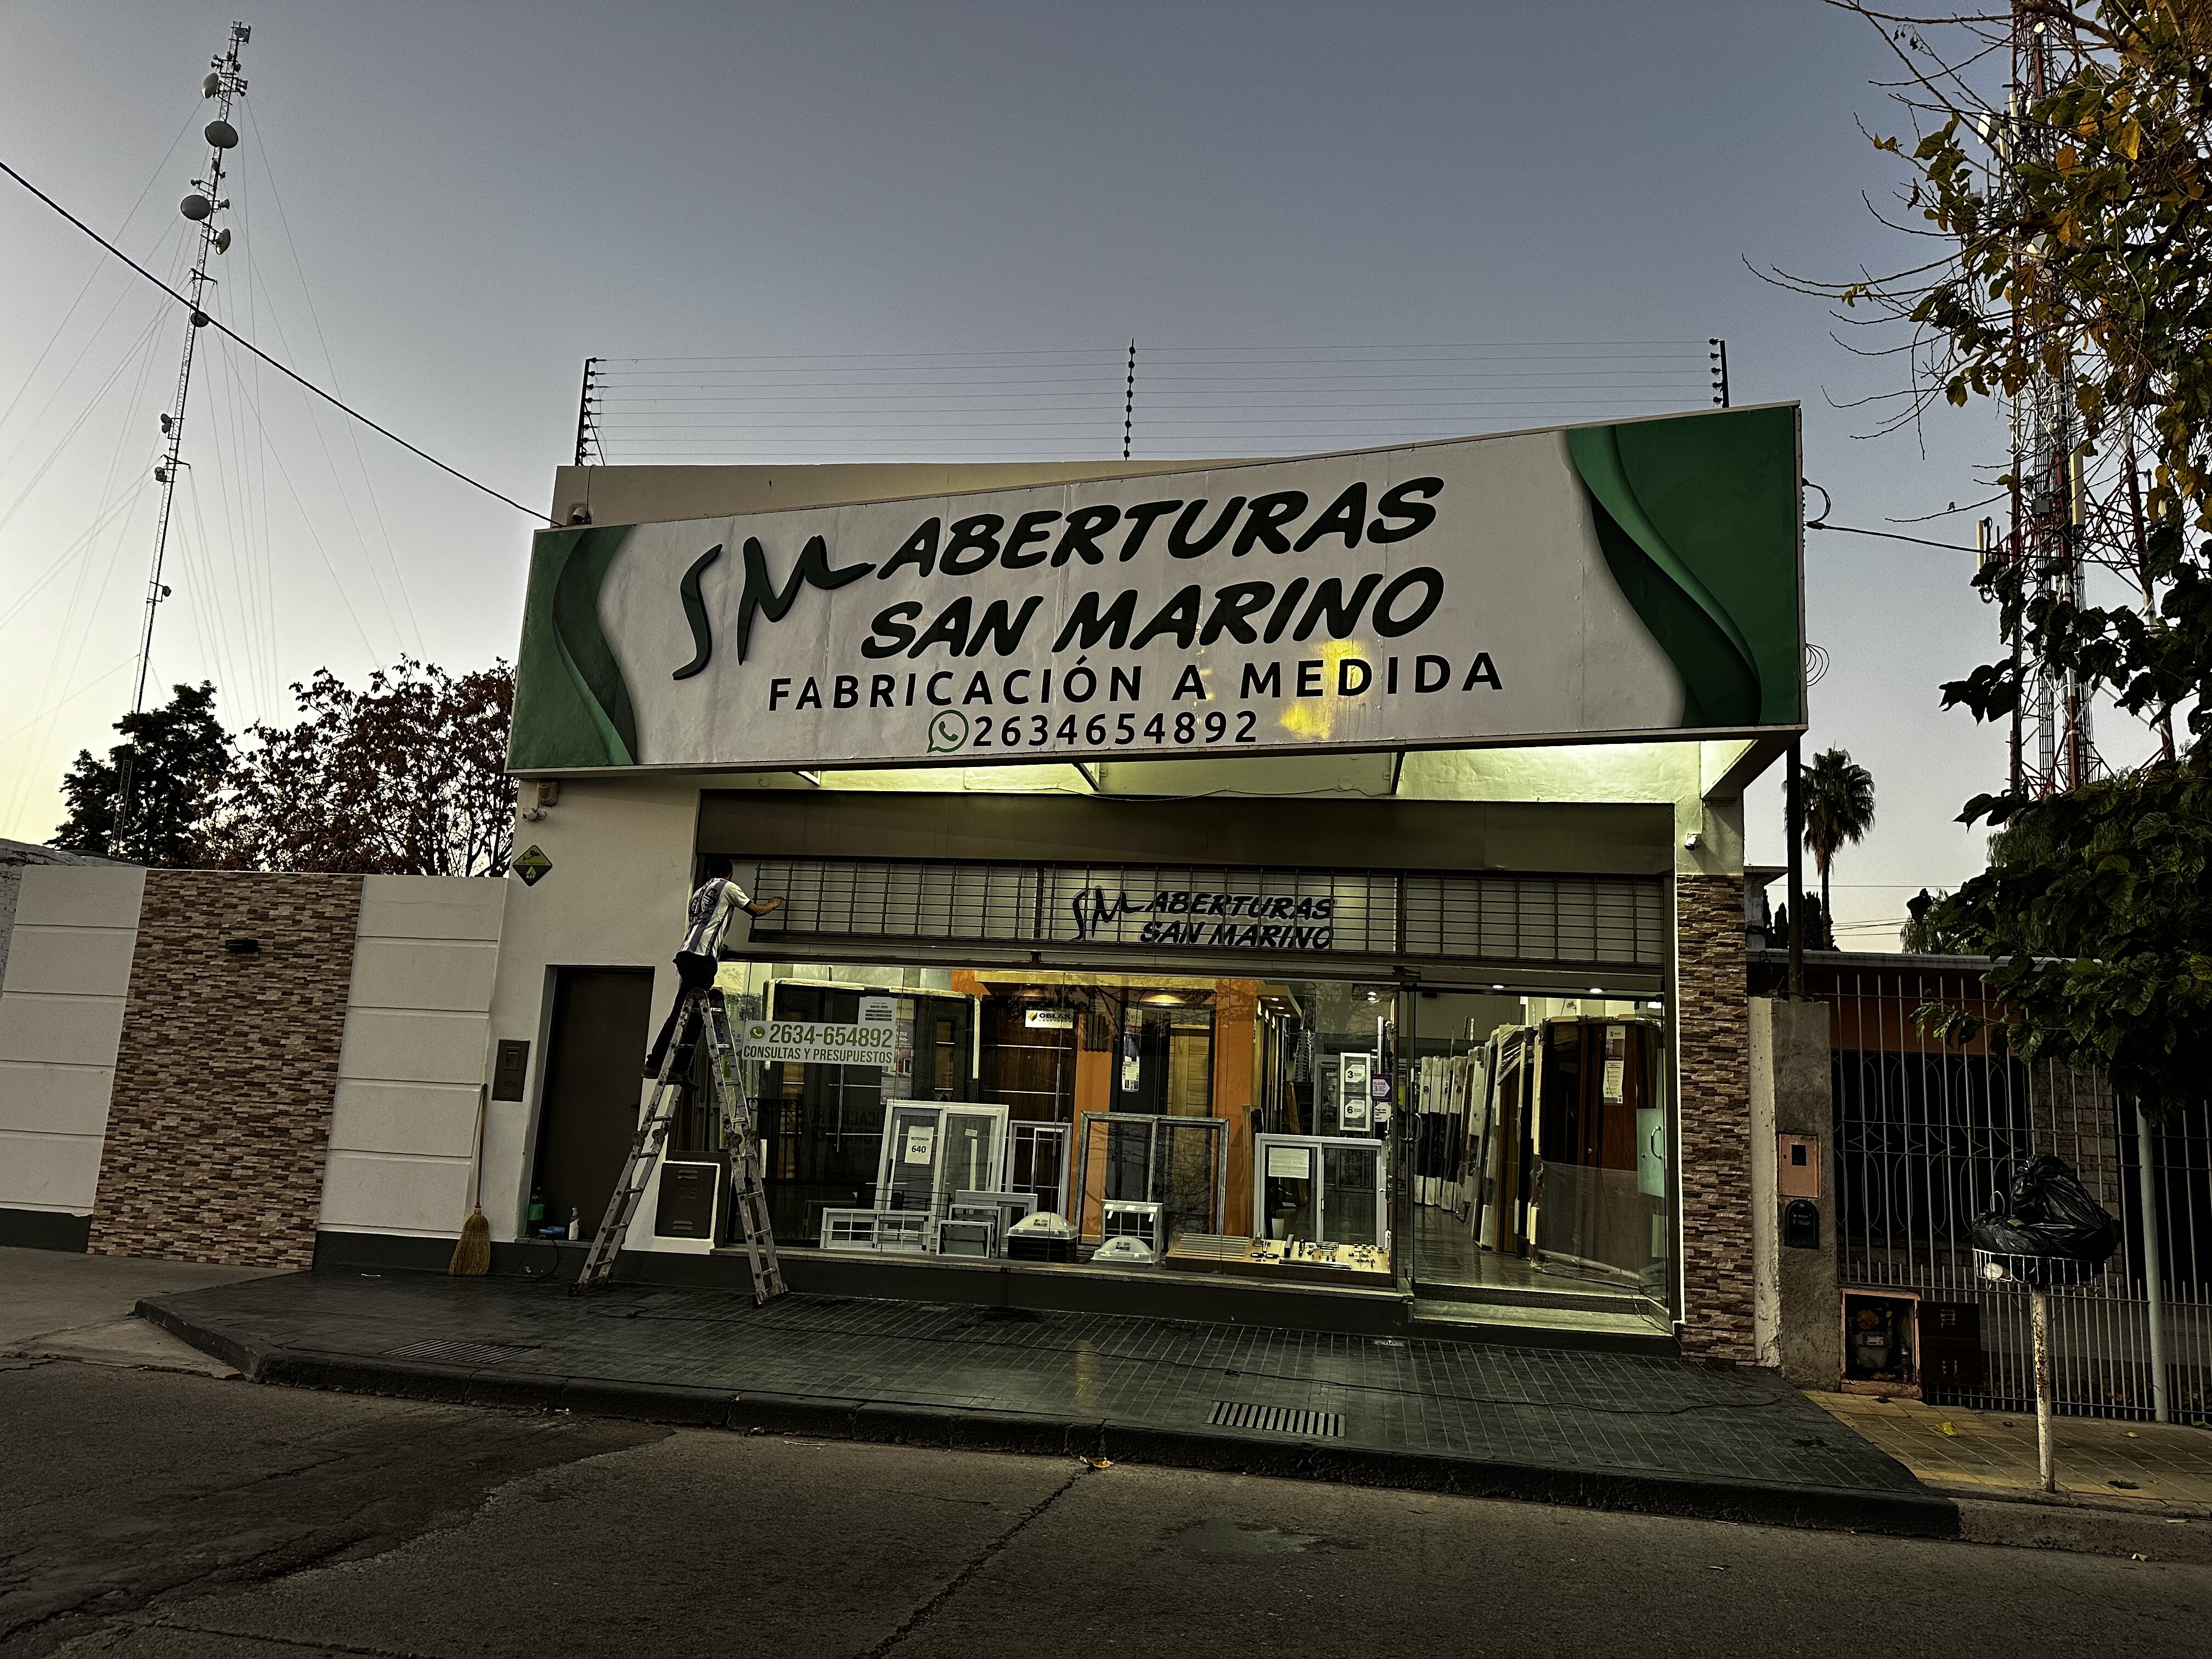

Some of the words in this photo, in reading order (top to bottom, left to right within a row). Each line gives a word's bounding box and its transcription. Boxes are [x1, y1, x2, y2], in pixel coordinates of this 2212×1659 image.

[877, 476, 1444, 580] ABERTURAS
[861, 596, 1043, 659] SAN
[1052, 567, 1444, 653] MARINO
[769, 655, 1142, 711] FABRICACIÓN
[1172, 664, 1207, 701] A
[1240, 652, 1503, 699] MEDIDA
[973, 710, 1257, 747] 2634654892
[1144, 891, 1337, 920] ABERTURAS
[1140, 920, 1206, 944] SAN
[1208, 923, 1334, 949] MARINO
[769, 1024, 893, 1048] 2634-654892
[743, 1046, 801, 1060] CONSULTAS
[804, 1048, 811, 1059] Y
[813, 1048, 893, 1064] PRESUPUESTOS
